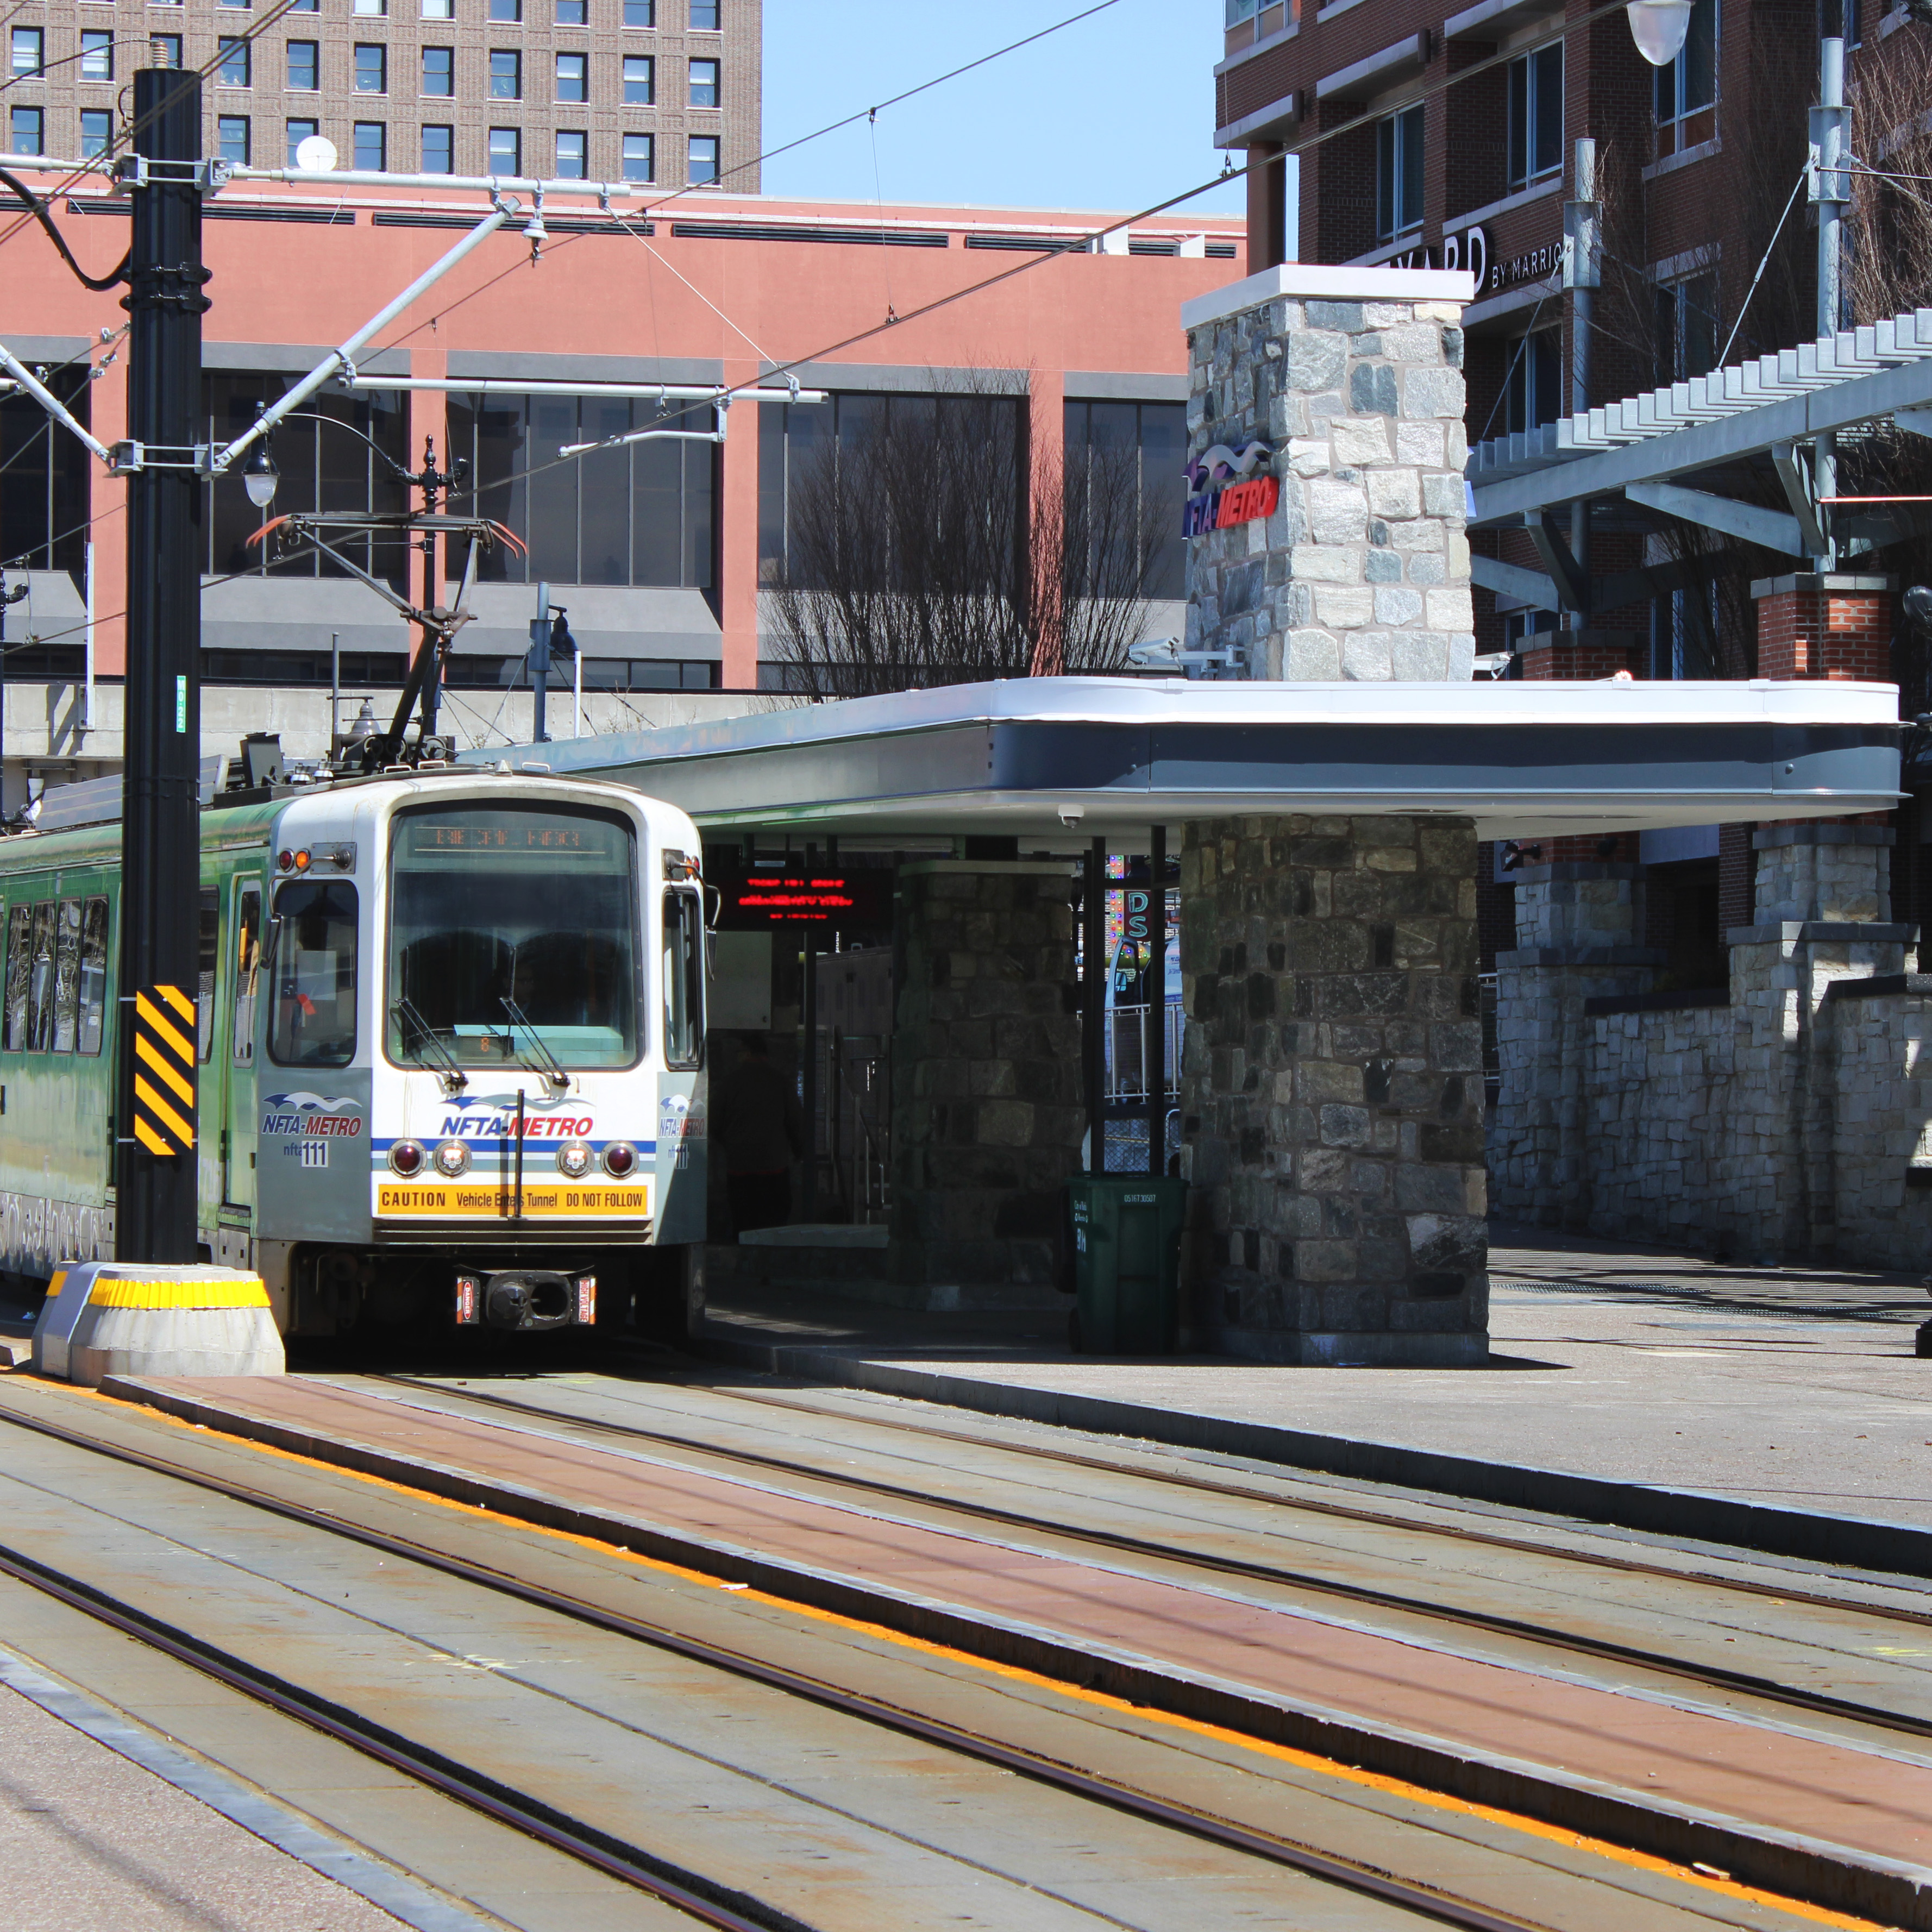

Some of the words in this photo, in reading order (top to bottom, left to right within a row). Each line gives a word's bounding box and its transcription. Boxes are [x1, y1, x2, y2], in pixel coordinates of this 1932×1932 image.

[1492, 262, 1507, 288] BY
[1513, 242, 1562, 281] MARRIO
[262, 1114, 362, 1138] NFTA-METRO
[440, 1116, 593, 1137] NFTA-METRO
[658, 1117, 705, 1137] NFTA-METRO
[303, 1141, 326, 1166] 111
[381, 1191, 446, 1207] CAUTION
[456, 1192, 492, 1207] Vehicle
[495, 1192, 524, 1207] Entes
[526, 1193, 557, 1207] Tunnel
[566, 1193, 579, 1207] DO
[582, 1193, 601, 1207] NOT
[604, 1193, 643, 1207] FOLLOW
[580, 1279, 588, 1295] HIGH
[580, 1296, 588, 1321] VOLTAGE
